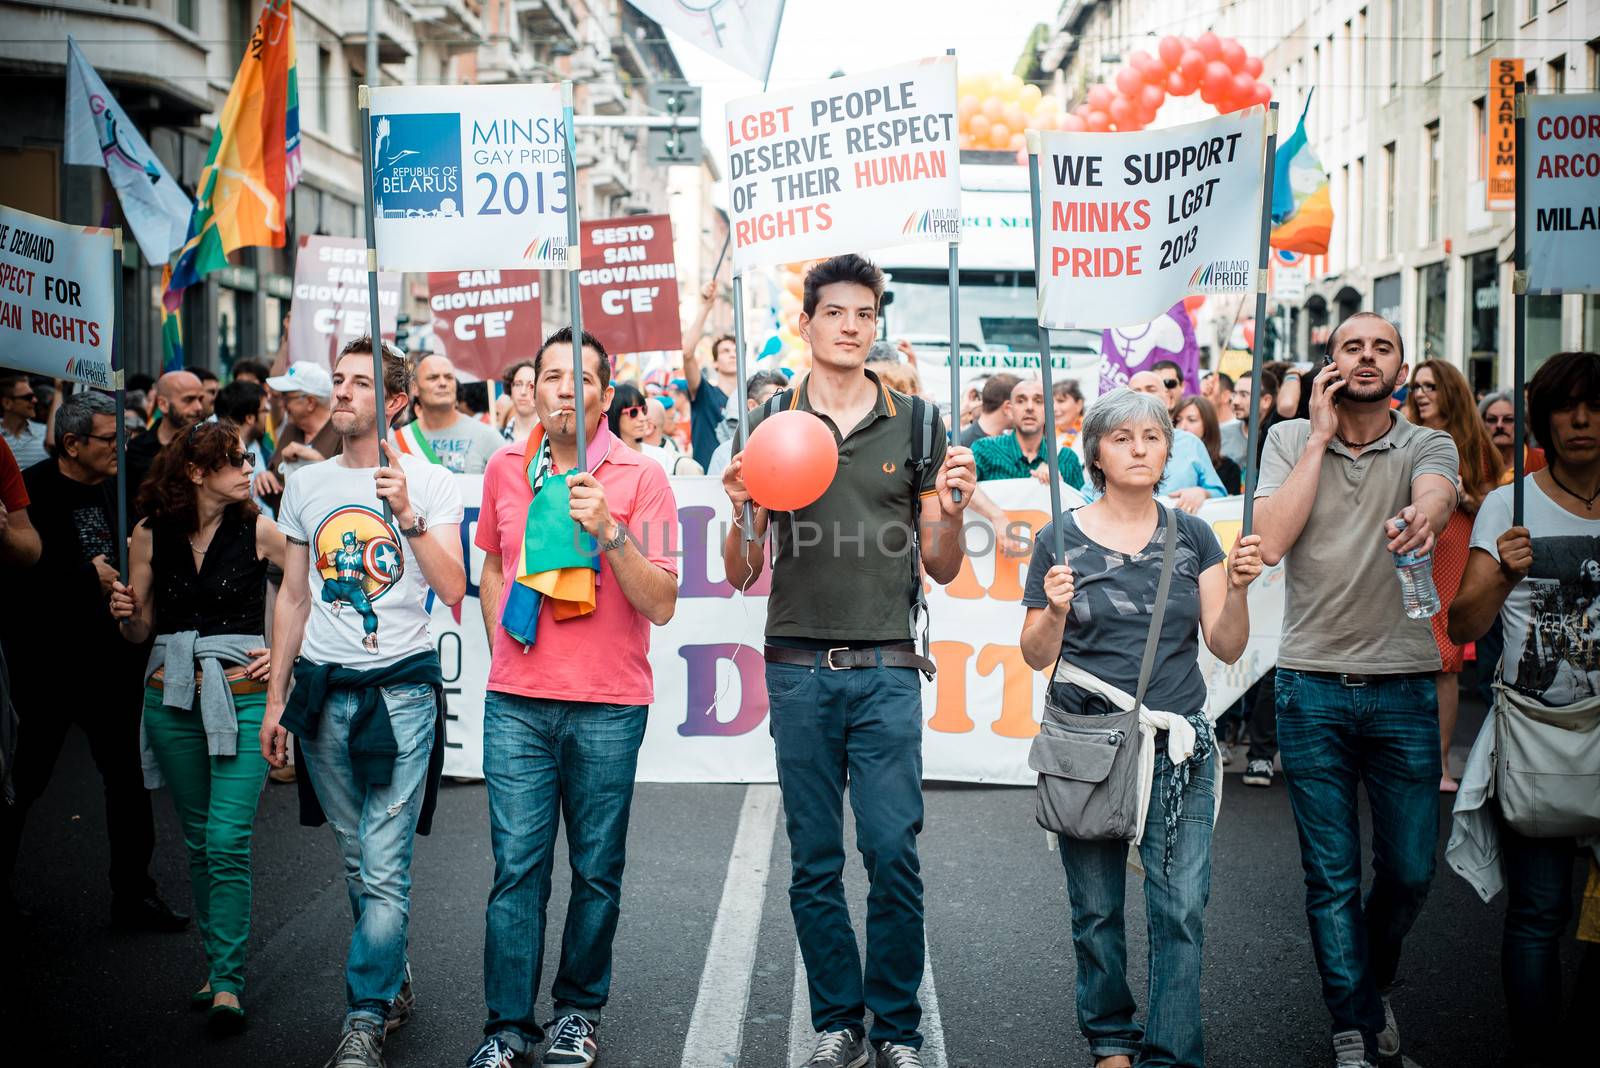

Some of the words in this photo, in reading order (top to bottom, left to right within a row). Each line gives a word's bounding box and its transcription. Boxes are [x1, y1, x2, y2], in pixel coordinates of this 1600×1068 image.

[728, 106, 794, 147] LGBT
[811, 81, 917, 127] PEOPLE
[1496, 60, 1515, 166] SOLARIUM
[472, 118, 565, 145] MINSK
[473, 149, 513, 165] GAY
[520, 149, 567, 164] PRIDE
[730, 132, 833, 180] DESERVE
[846, 113, 953, 154] RESPECT
[393, 167, 440, 177] REPUBLIC
[443, 166, 458, 176] OF
[1052, 154, 1103, 187] WE
[1124, 133, 1242, 186] SUPPORT
[1537, 154, 1600, 179] ARCO
[383, 175, 457, 193] BELARUS
[475, 171, 568, 216] 2013
[733, 182, 758, 213] OF
[772, 166, 841, 203] THEIR
[854, 150, 947, 188] HUMAN
[1052, 199, 1151, 233] MINKS
[1168, 178, 1220, 225] LGBT
[735, 202, 833, 248] RIGHTS
[933, 219, 960, 234] PRIDE
[1537, 206, 1600, 232] MILA
[9, 229, 55, 264] DEMAND
[591, 224, 654, 245] SESTO
[319, 246, 367, 265] SEST
[552, 247, 568, 261] PRI
[603, 245, 646, 264] SAN
[1052, 245, 1142, 278] PRIDE
[1159, 225, 1199, 270] 2013
[327, 267, 369, 284] SAN
[578, 262, 676, 286] GIOVANNI
[1214, 260, 1250, 272] MILANO
[457, 269, 502, 289] SAN
[1214, 272, 1249, 286] PRIDE
[44, 276, 82, 307] FOR
[0, 300, 22, 330] AN
[32, 309, 100, 348] RIGHTS
[83, 359, 107, 375] MILANO
[85, 368, 108, 384] PRIDE
